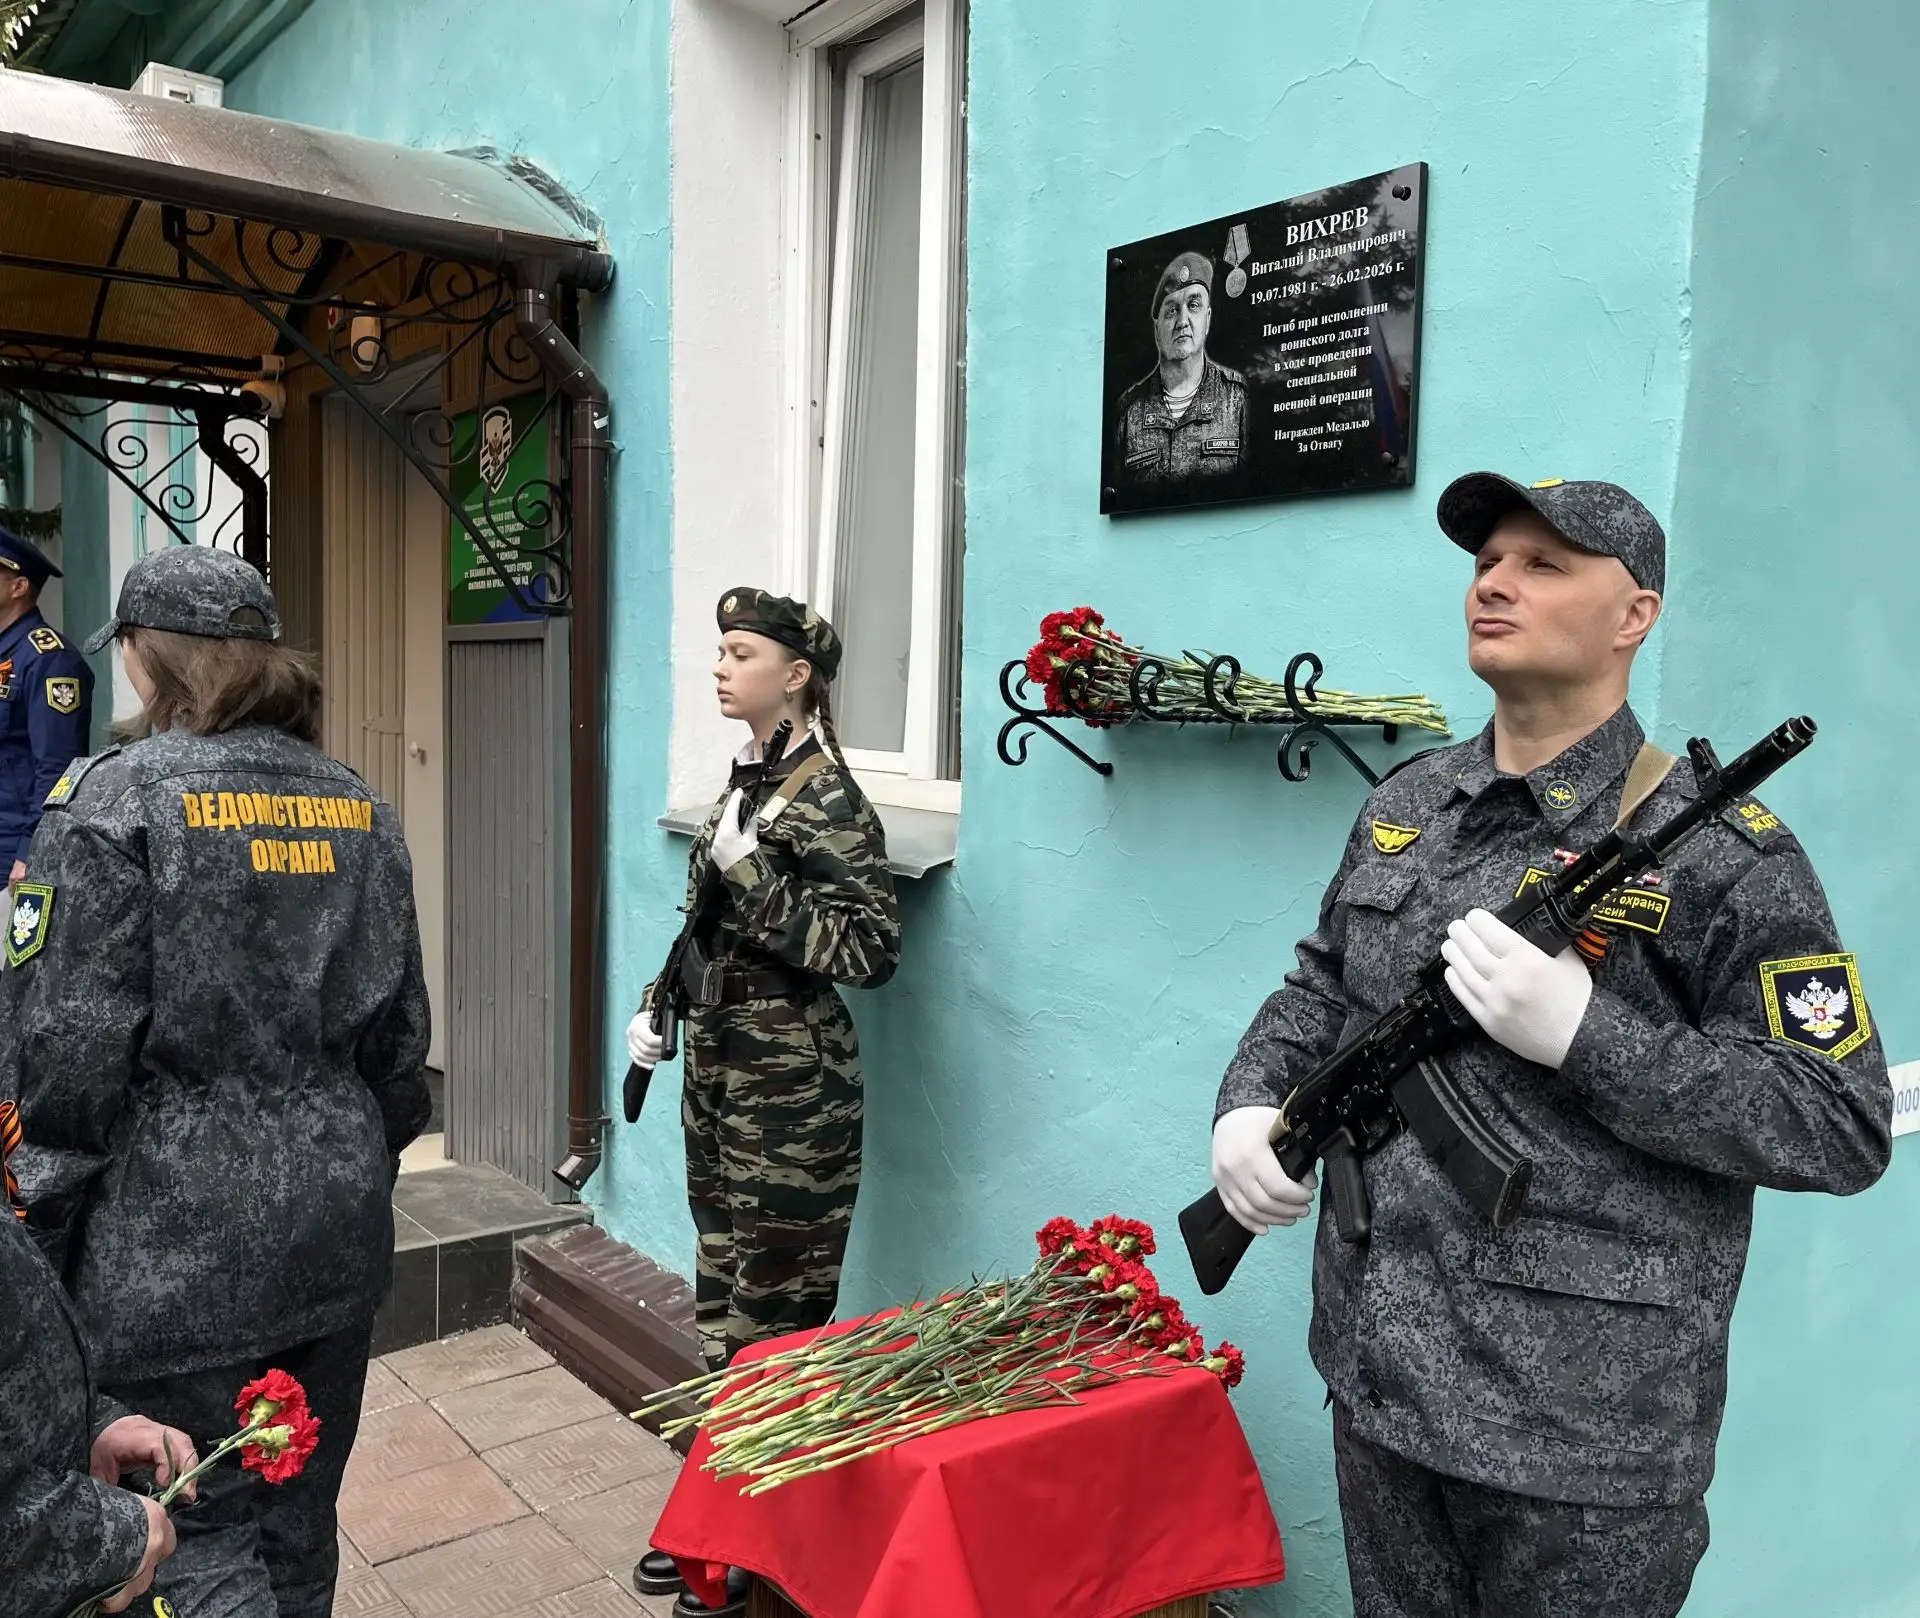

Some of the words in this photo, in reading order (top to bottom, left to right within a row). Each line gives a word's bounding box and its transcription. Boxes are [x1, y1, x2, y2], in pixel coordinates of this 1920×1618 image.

[1285, 206, 1369, 246] ВИХРЕВ
[1251, 251, 1304, 276] Виталий
[1308, 229, 1406, 262] Владимирович
[1251, 282, 1306, 305] 19.07.1981
[1310, 281, 1319, 291] г.
[1330, 260, 1393, 287] 26.02.2026
[1396, 261, 1405, 272] г.
[1262, 319, 1296, 338] Погиб
[1298, 316, 1318, 332] при
[1321, 302, 1388, 325] исполнении
[1280, 332, 1336, 352] воинского
[1337, 326, 1370, 342] долга
[1274, 362, 1281, 372] в
[1282, 358, 1306, 371] ходе
[1308, 345, 1372, 367] проведения
[1286, 365, 1357, 388] специальной
[1273, 394, 1316, 412] военной
[1319, 388, 1373, 405] операции
[1274, 425, 1324, 441] Награжден
[1326, 419, 1370, 433] Медалью
[1297, 442, 1308, 453] За
[1310, 439, 1343, 451] Отвагу
[182, 791, 372, 833] ВЕДОМСТВЕННАЯ
[1739, 803, 1762, 819] ВО
[250, 838, 336, 874] ОХРАНА
[1619, 895, 1663, 914] охрана
[1777, 959, 1828, 970] КРАСНОЯРСКАЯ
